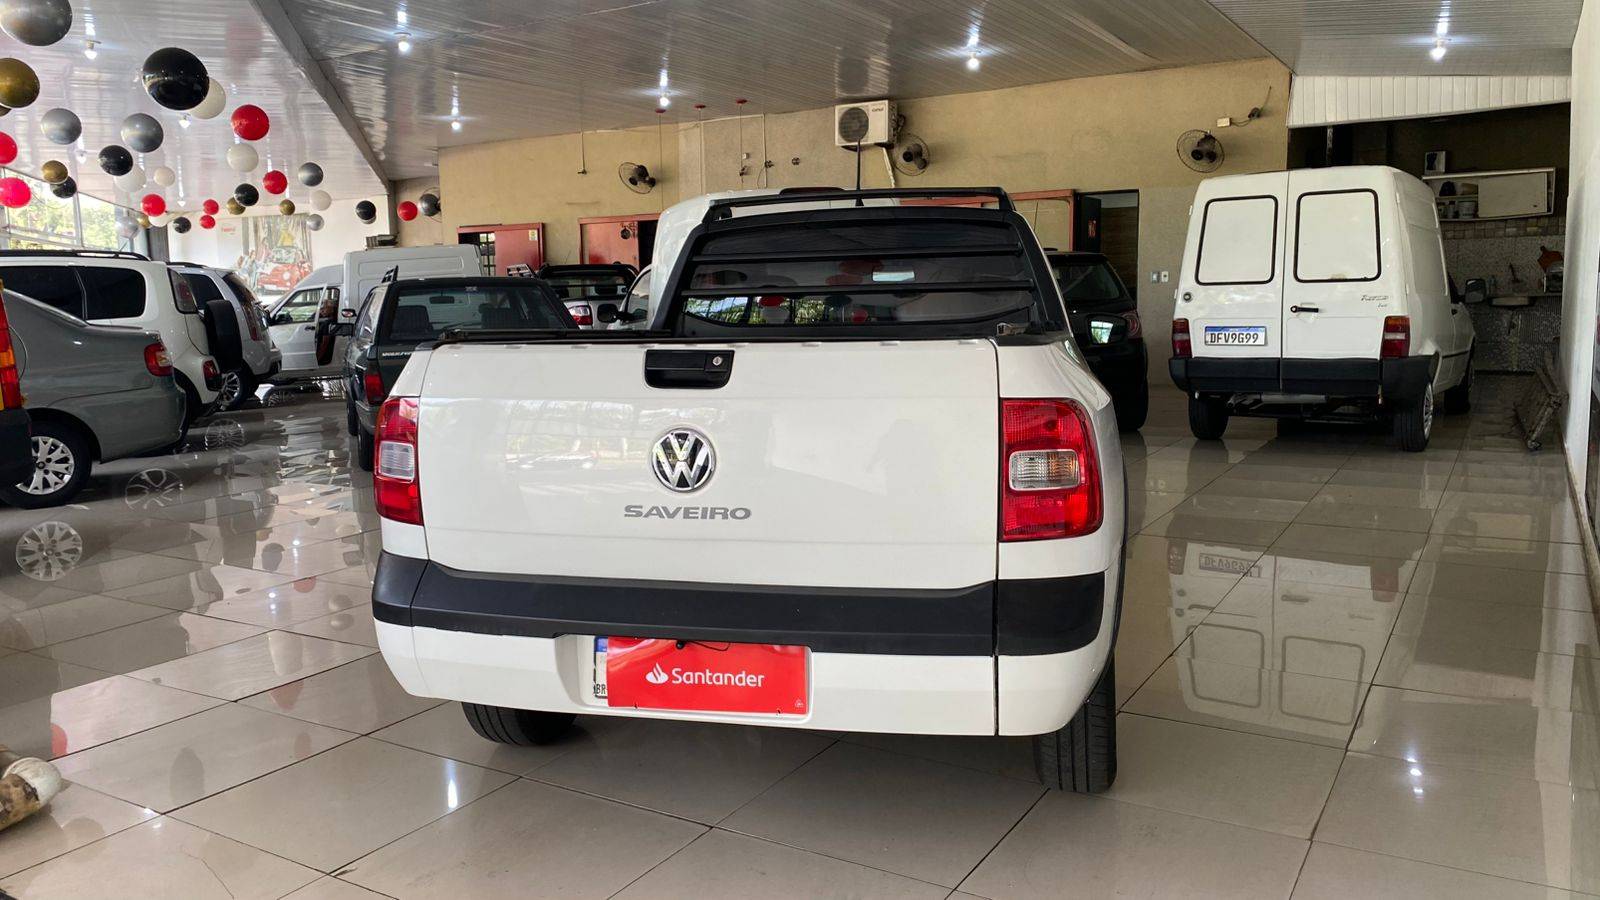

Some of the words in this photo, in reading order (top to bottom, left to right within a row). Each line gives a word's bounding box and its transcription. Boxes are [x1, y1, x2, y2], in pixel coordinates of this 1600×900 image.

[1210, 332, 1259, 344] DFV9G99
[652, 428, 714, 492] VW
[624, 504, 752, 520] SAVEIRO
[671, 667, 765, 687] Santander
